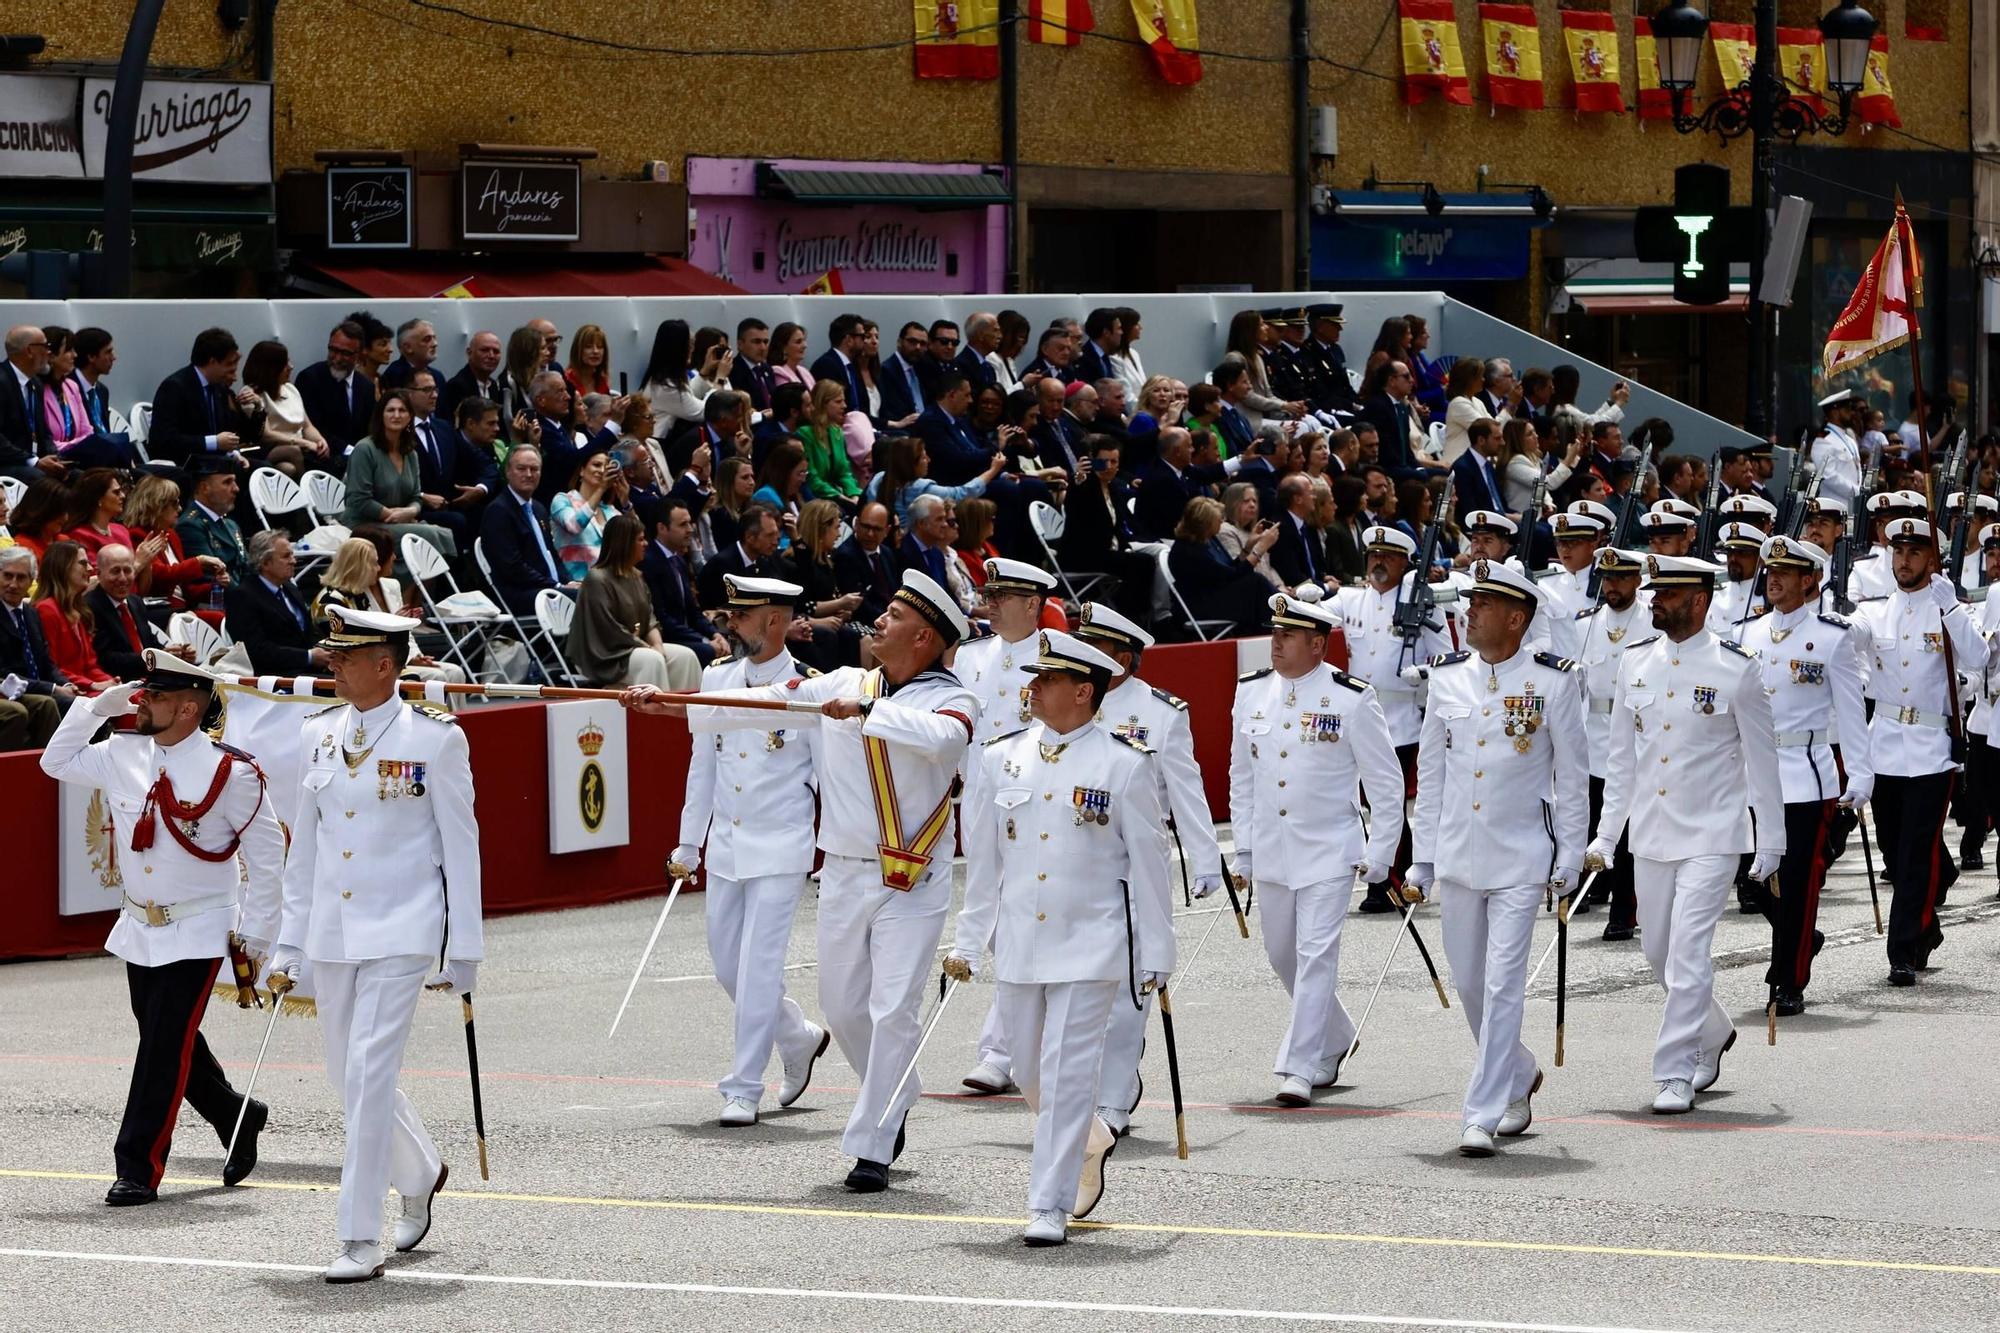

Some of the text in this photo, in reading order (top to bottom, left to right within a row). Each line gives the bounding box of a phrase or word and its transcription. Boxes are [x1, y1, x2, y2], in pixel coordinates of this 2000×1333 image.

[478, 168, 565, 215] Andares
[778, 218, 939, 283] Gemma Estilistas
